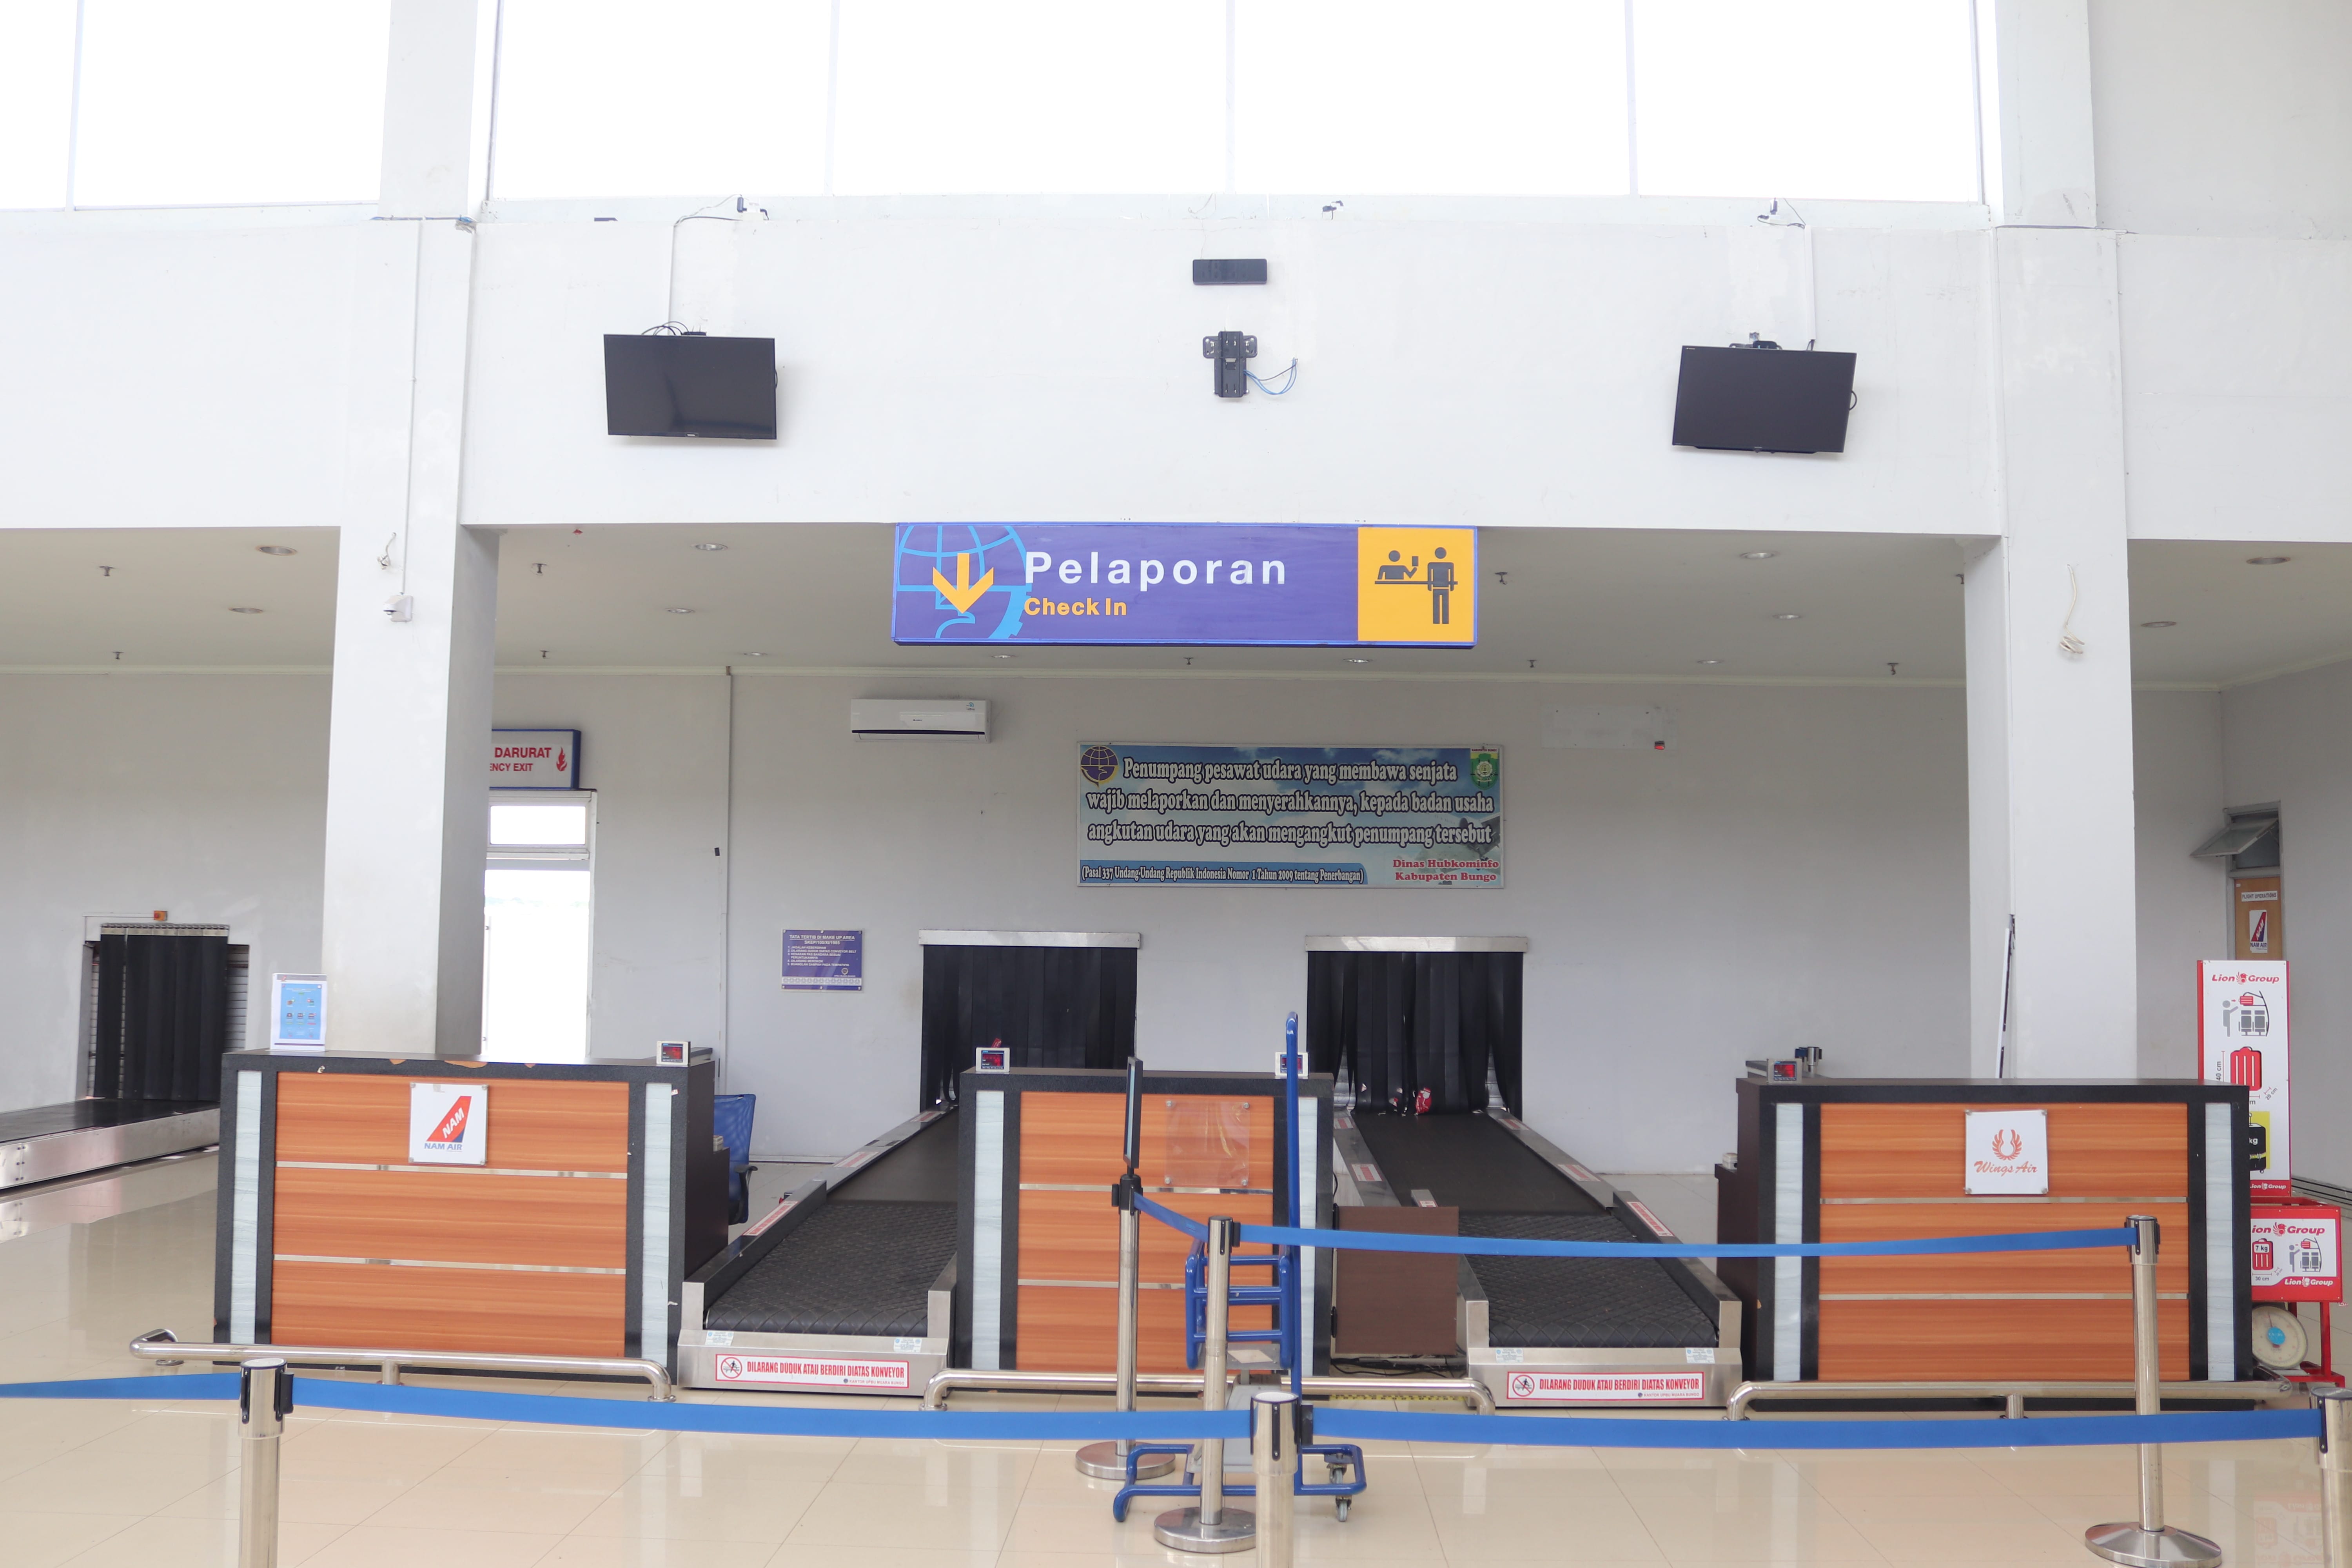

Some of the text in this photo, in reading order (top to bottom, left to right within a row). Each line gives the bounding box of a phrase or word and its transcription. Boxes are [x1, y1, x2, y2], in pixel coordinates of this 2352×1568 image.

[1026, 552, 1285, 591] Pelaporan
[1024, 598, 1127, 616] Check In
[495, 747, 552, 758] DARURAT
[514, 763, 533, 771] EXIT
[1123, 757, 1458, 785] Penumpang pesawat udara yang membawa senjata
[1086, 788, 1494, 816] wajib melaporkan dan menyerahkannya, kepada badan usaha
[1087, 819, 1492, 848] angkutan udara yang akan mengangkut penumpang tersebut
[1393, 859, 1499, 869] Dinas Hubkominfo
[1082, 866, 1364, 884] (Pasal 337 Undang-Undang Republik Indonesia Nomor 1 Tahun 2009 tentang Penerbangan)
[1395, 872, 1497, 882] Kabupaten Bungo
[2256, 919, 2264, 940] NAM
[2248, 975, 2279, 984] Group
[2216, 1061, 2221, 1081] 40 cm
[442, 1107, 465, 1139] NAM
[1974, 1160, 2038, 1176] Wings Air
[2252, 1225, 2325, 1236] ion Group
[747, 1361, 904, 1378] DILARANG DUDUK ATAU BERDIRI DIATAS KONVEYOR
[1540, 1378, 1699, 1390] DILARANG DUDUK ATAU BERDIRI DIATAS KONVEYOR
